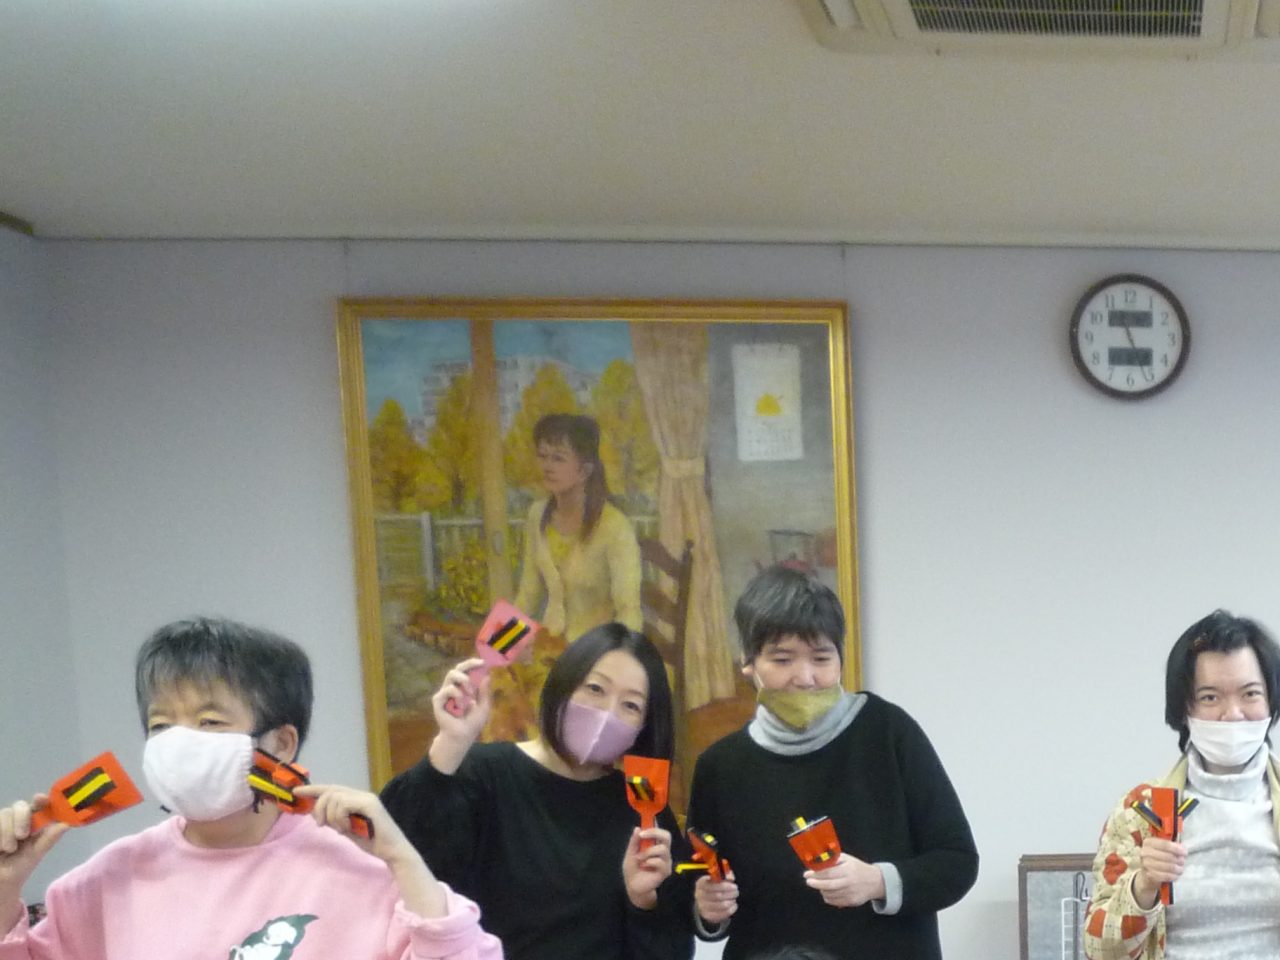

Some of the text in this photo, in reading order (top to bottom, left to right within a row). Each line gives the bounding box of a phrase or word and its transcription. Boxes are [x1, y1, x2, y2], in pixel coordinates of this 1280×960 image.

[1105, 294, 1115, 310] 11
[1123, 289, 1137, 304] 12
[1149, 295, 1154, 309] 1
[1090, 311, 1103, 325] 10
[1160, 311, 1169, 325] 2
[1084, 331, 1094, 345] 9
[1167, 332, 1176, 346] 3
[1092, 352, 1100, 365] 8
[1160, 353, 1168, 367] 4
[1107, 367, 1116, 381] 7
[1126, 372, 1135, 387] 6
